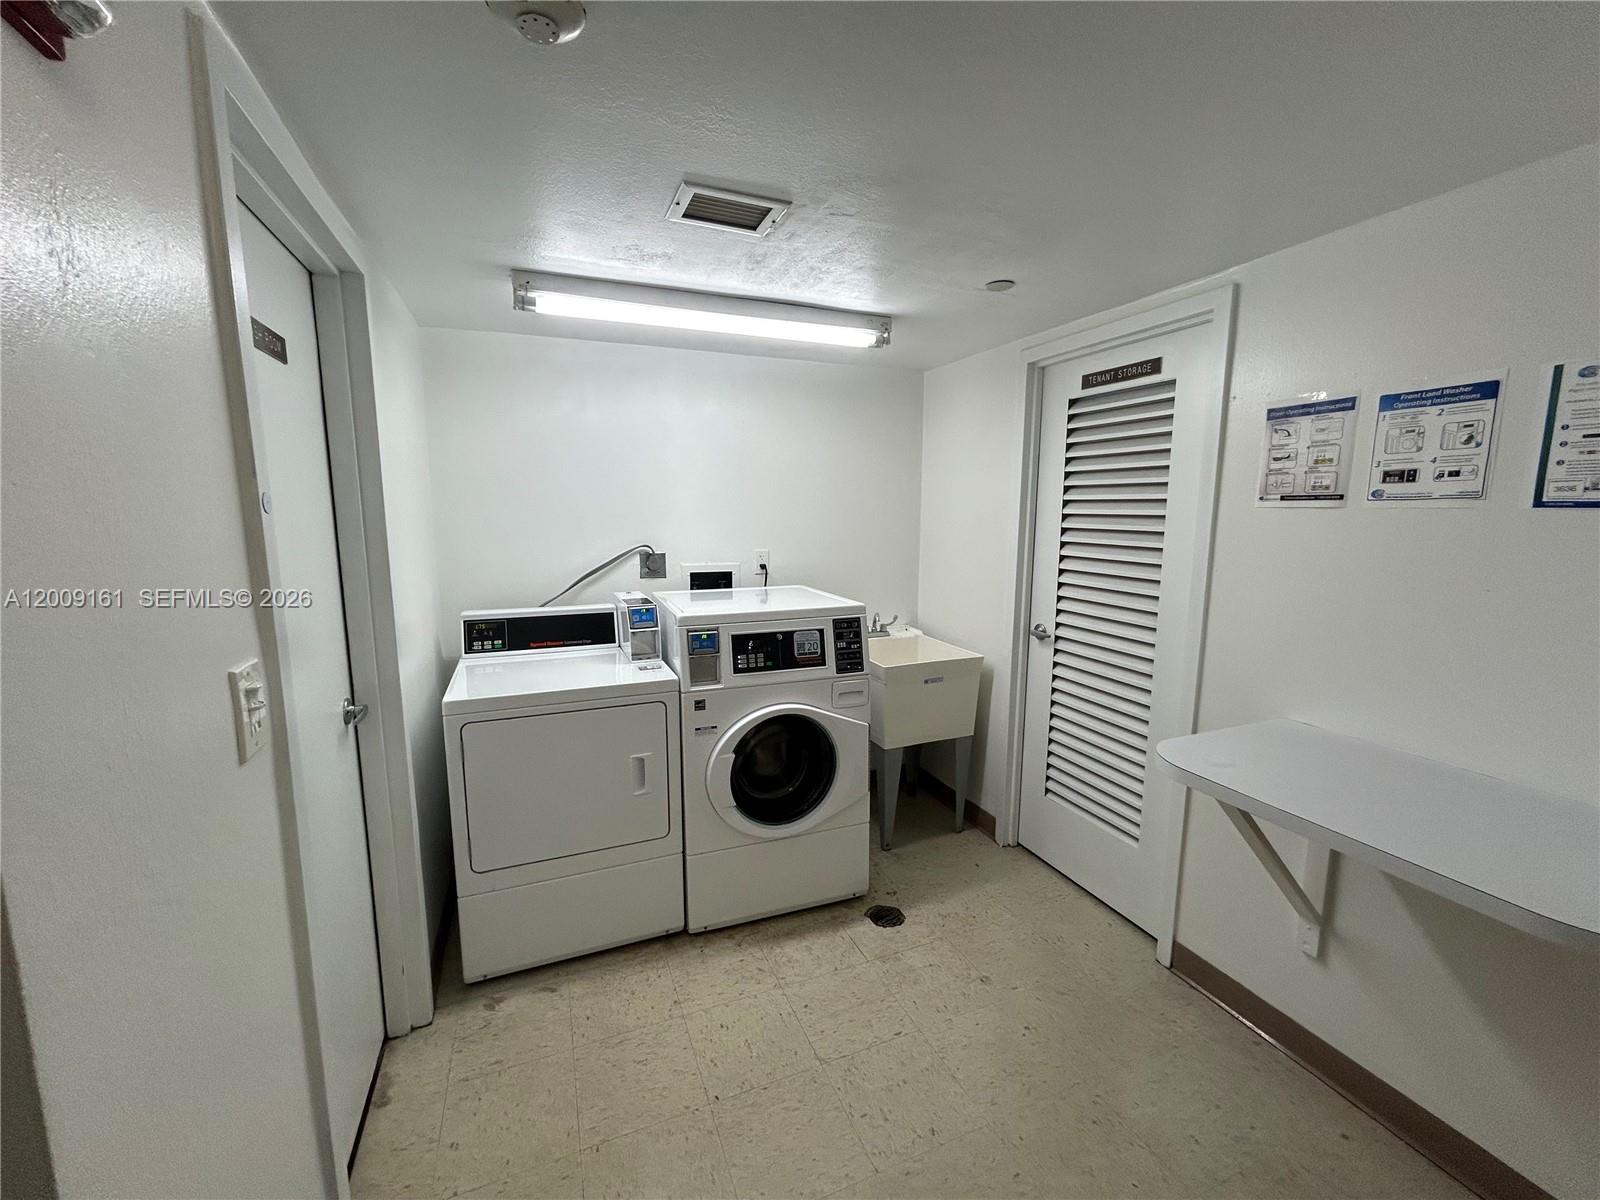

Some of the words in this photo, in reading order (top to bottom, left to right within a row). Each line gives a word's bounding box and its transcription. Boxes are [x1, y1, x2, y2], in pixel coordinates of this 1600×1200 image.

[1089, 372, 1114, 384] TENANT
[1118, 363, 1152, 378] STORAGE
[1401, 392, 1421, 400] Front
[1422, 389, 1441, 398] Load
[1443, 386, 1473, 395] Washer
[1393, 399, 1431, 409] Operating
